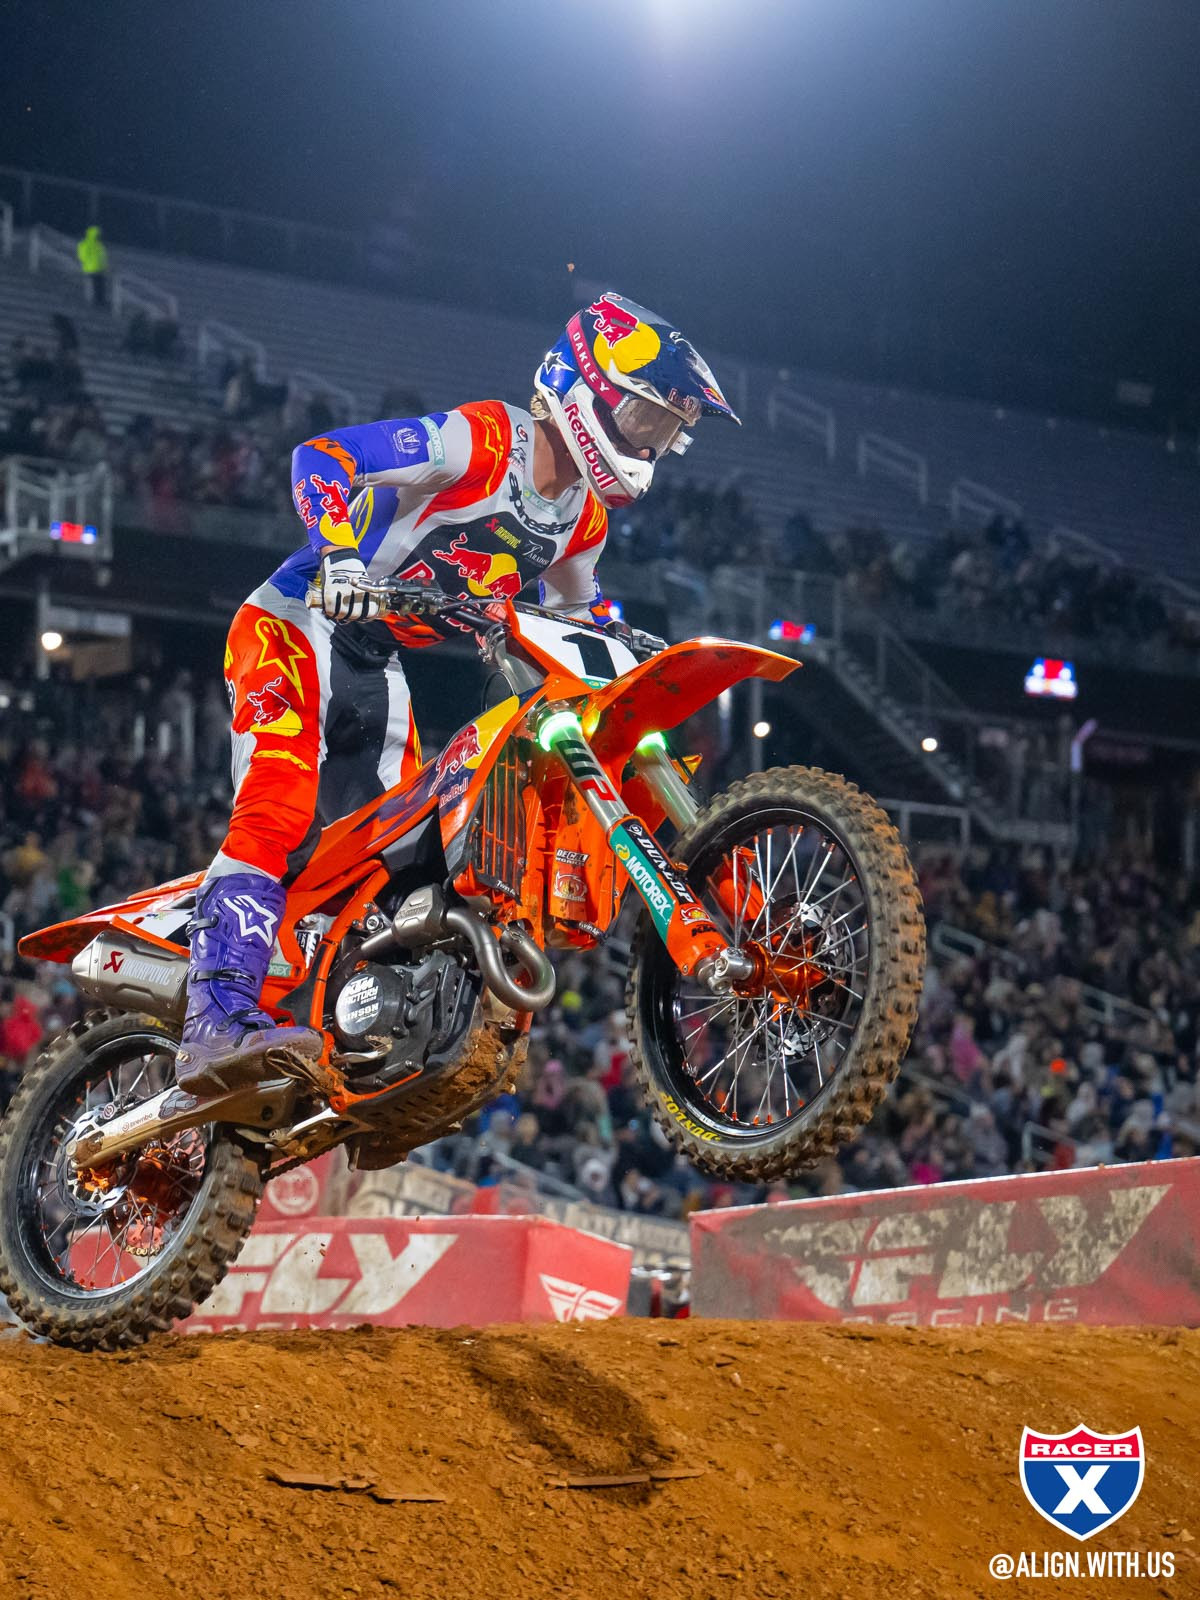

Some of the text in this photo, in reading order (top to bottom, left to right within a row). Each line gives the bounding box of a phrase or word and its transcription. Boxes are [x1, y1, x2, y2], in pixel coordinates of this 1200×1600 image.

[573, 331, 610, 392] OAKLEY
[625, 855, 671, 922] MOTOREX
[194, 1233, 459, 1316] FLY
